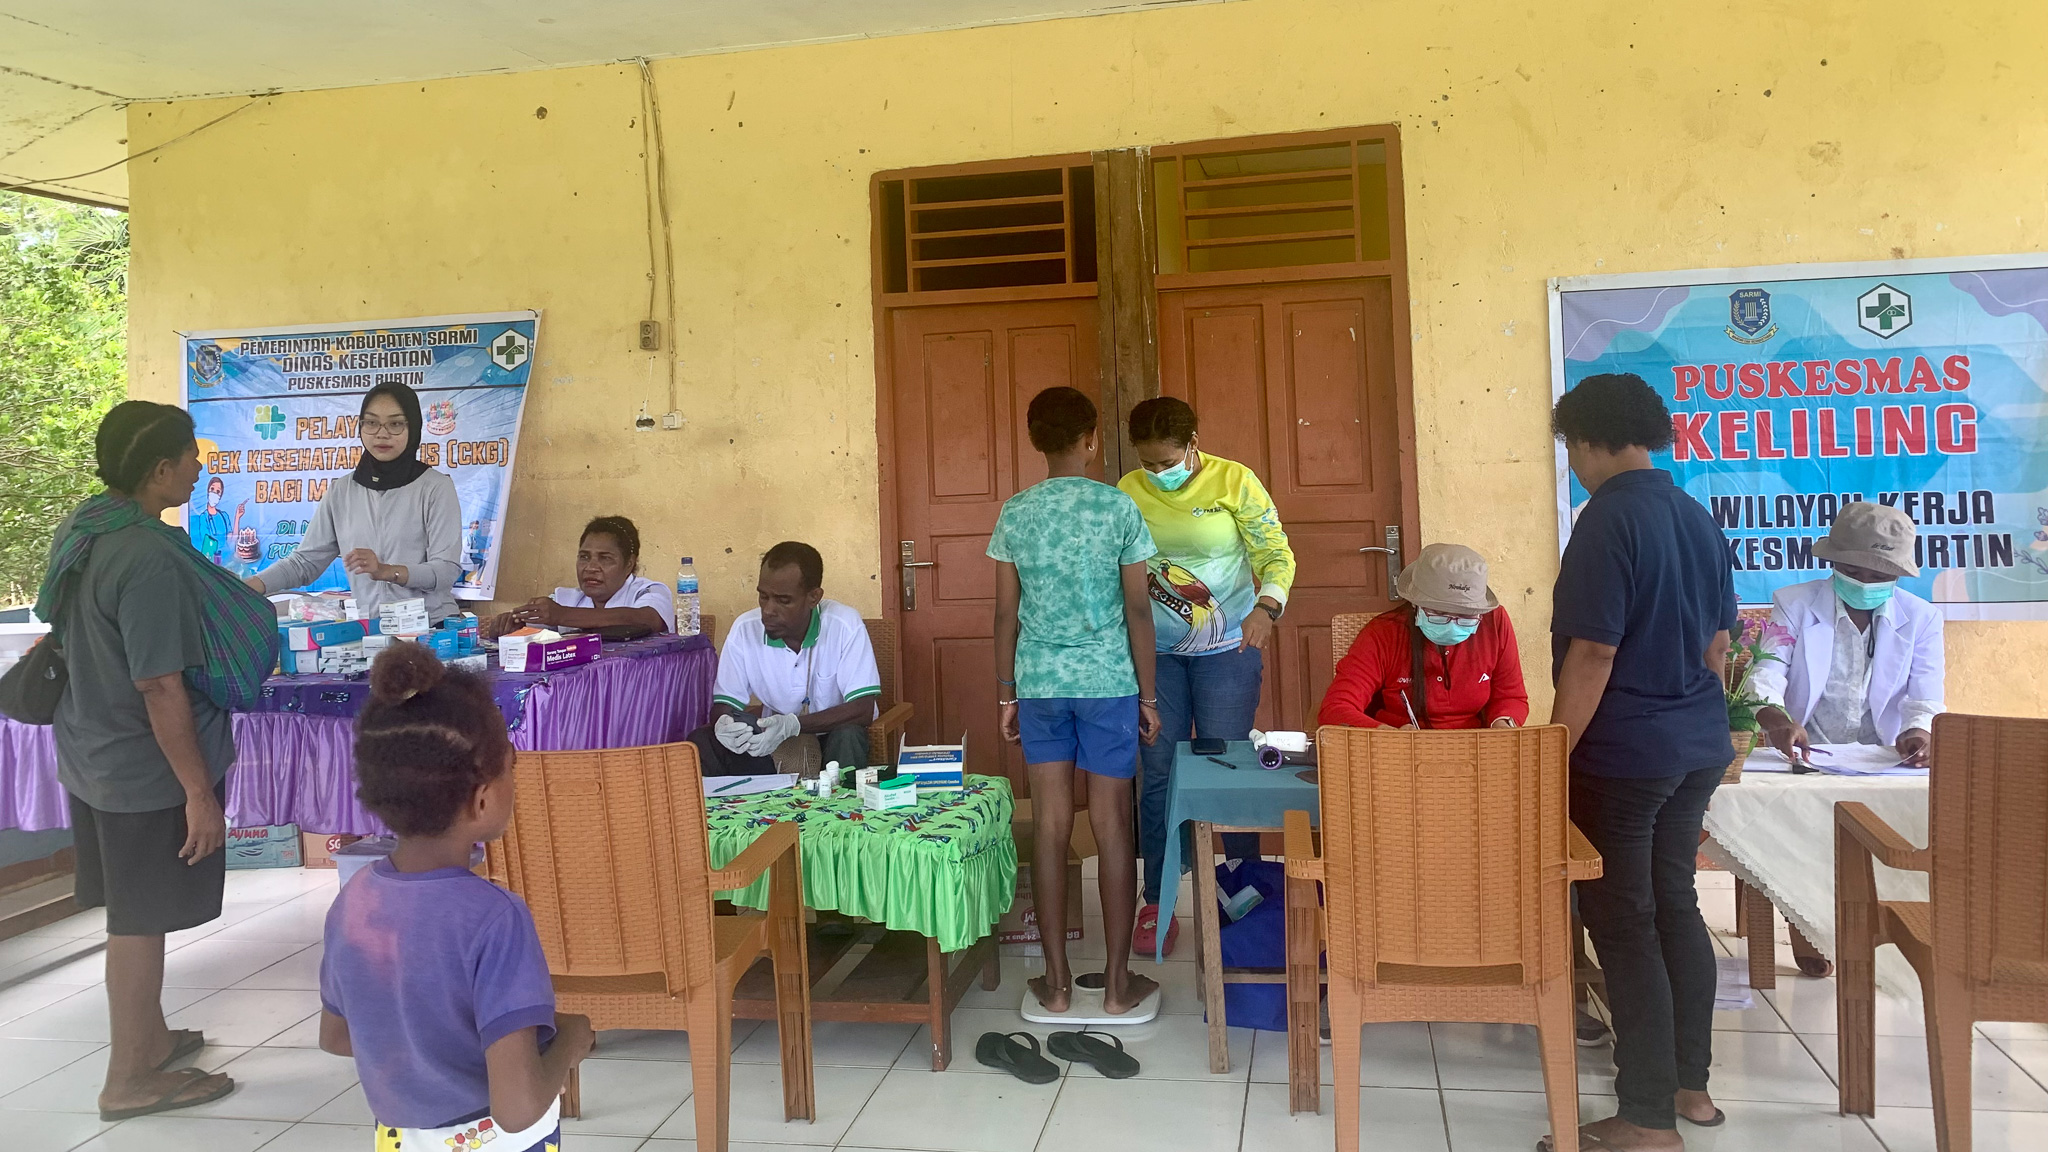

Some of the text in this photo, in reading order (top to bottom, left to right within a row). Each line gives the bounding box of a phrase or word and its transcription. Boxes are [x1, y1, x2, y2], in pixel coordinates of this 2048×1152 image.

[240, 329, 478, 356] PEMERINTAH KABUPATEN SARMI
[282, 350, 432, 373] DINAS KESEHATAN
[288, 374, 371, 391] PUSKESMAS
[1671, 354, 1971, 402] PUSKESMAS
[296, 415, 361, 440] PELAY
[1672, 403, 1978, 462] KELILING
[207, 450, 241, 474] CEK
[247, 446, 363, 472] KESEHATAN
[447, 437, 509, 468] (CKG)
[255, 480, 302, 503] BAGI
[1709, 492, 1863, 529] WILAYA
[276, 520, 296, 536] DI
[328, 839, 341, 850] SG
